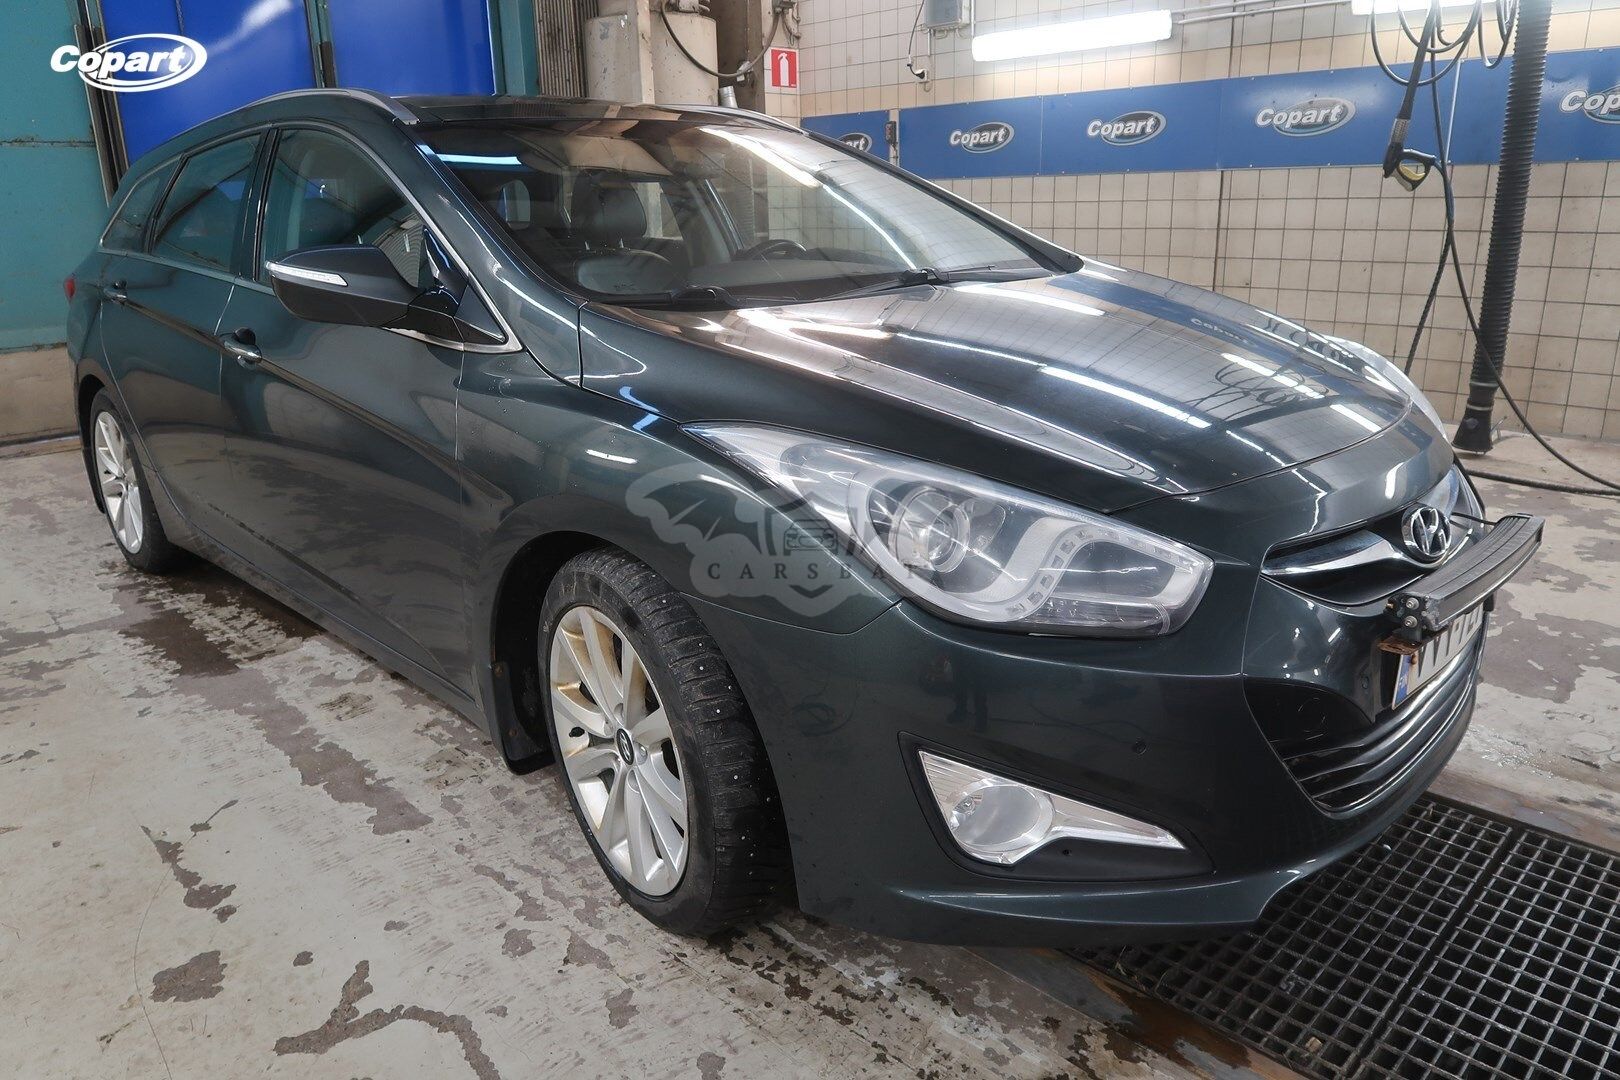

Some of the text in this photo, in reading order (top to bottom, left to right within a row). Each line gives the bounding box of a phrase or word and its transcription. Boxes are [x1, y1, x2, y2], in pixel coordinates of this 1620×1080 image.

[1561, 91, 1620, 115] Cop
[1086, 118, 1155, 138] Copart
[1257, 105, 1343, 129] Copart
[950, 127, 1005, 147] Copart
